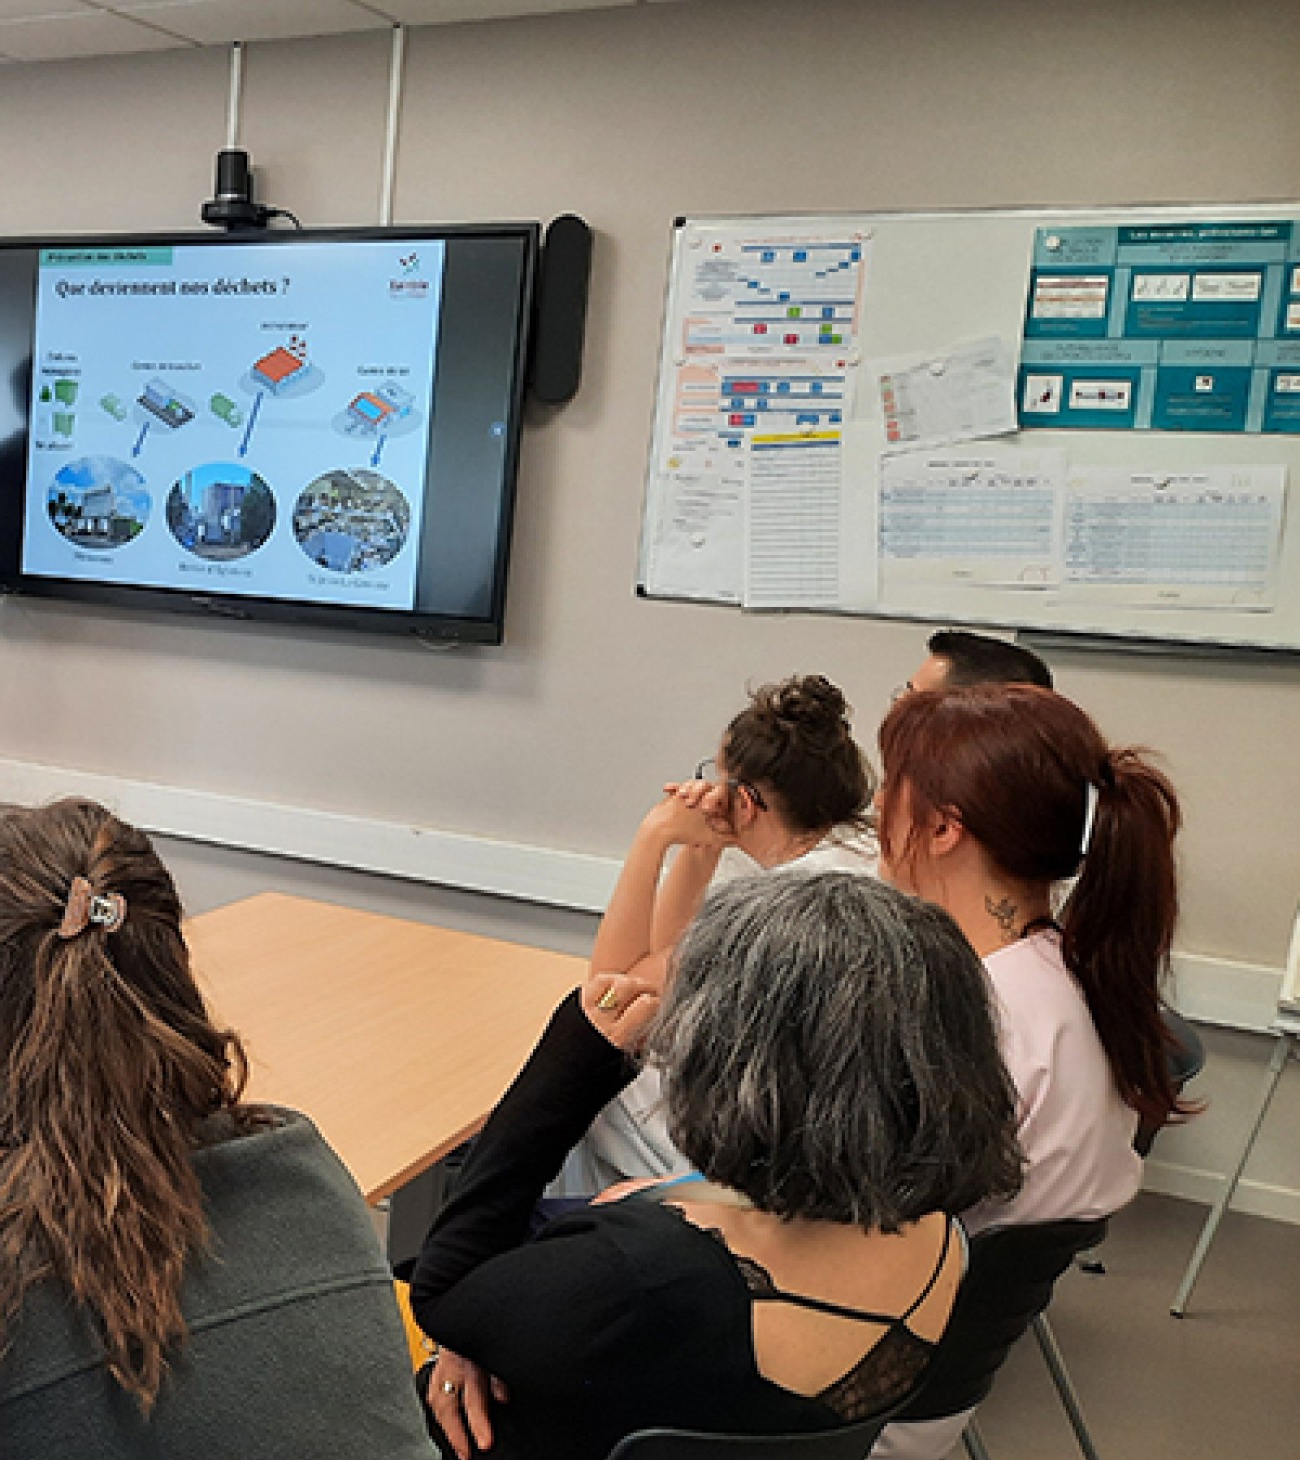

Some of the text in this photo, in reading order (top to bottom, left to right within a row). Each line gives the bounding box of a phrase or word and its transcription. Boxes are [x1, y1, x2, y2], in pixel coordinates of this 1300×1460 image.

[54, 276, 291, 298] Que deviennent nos déchets ?
